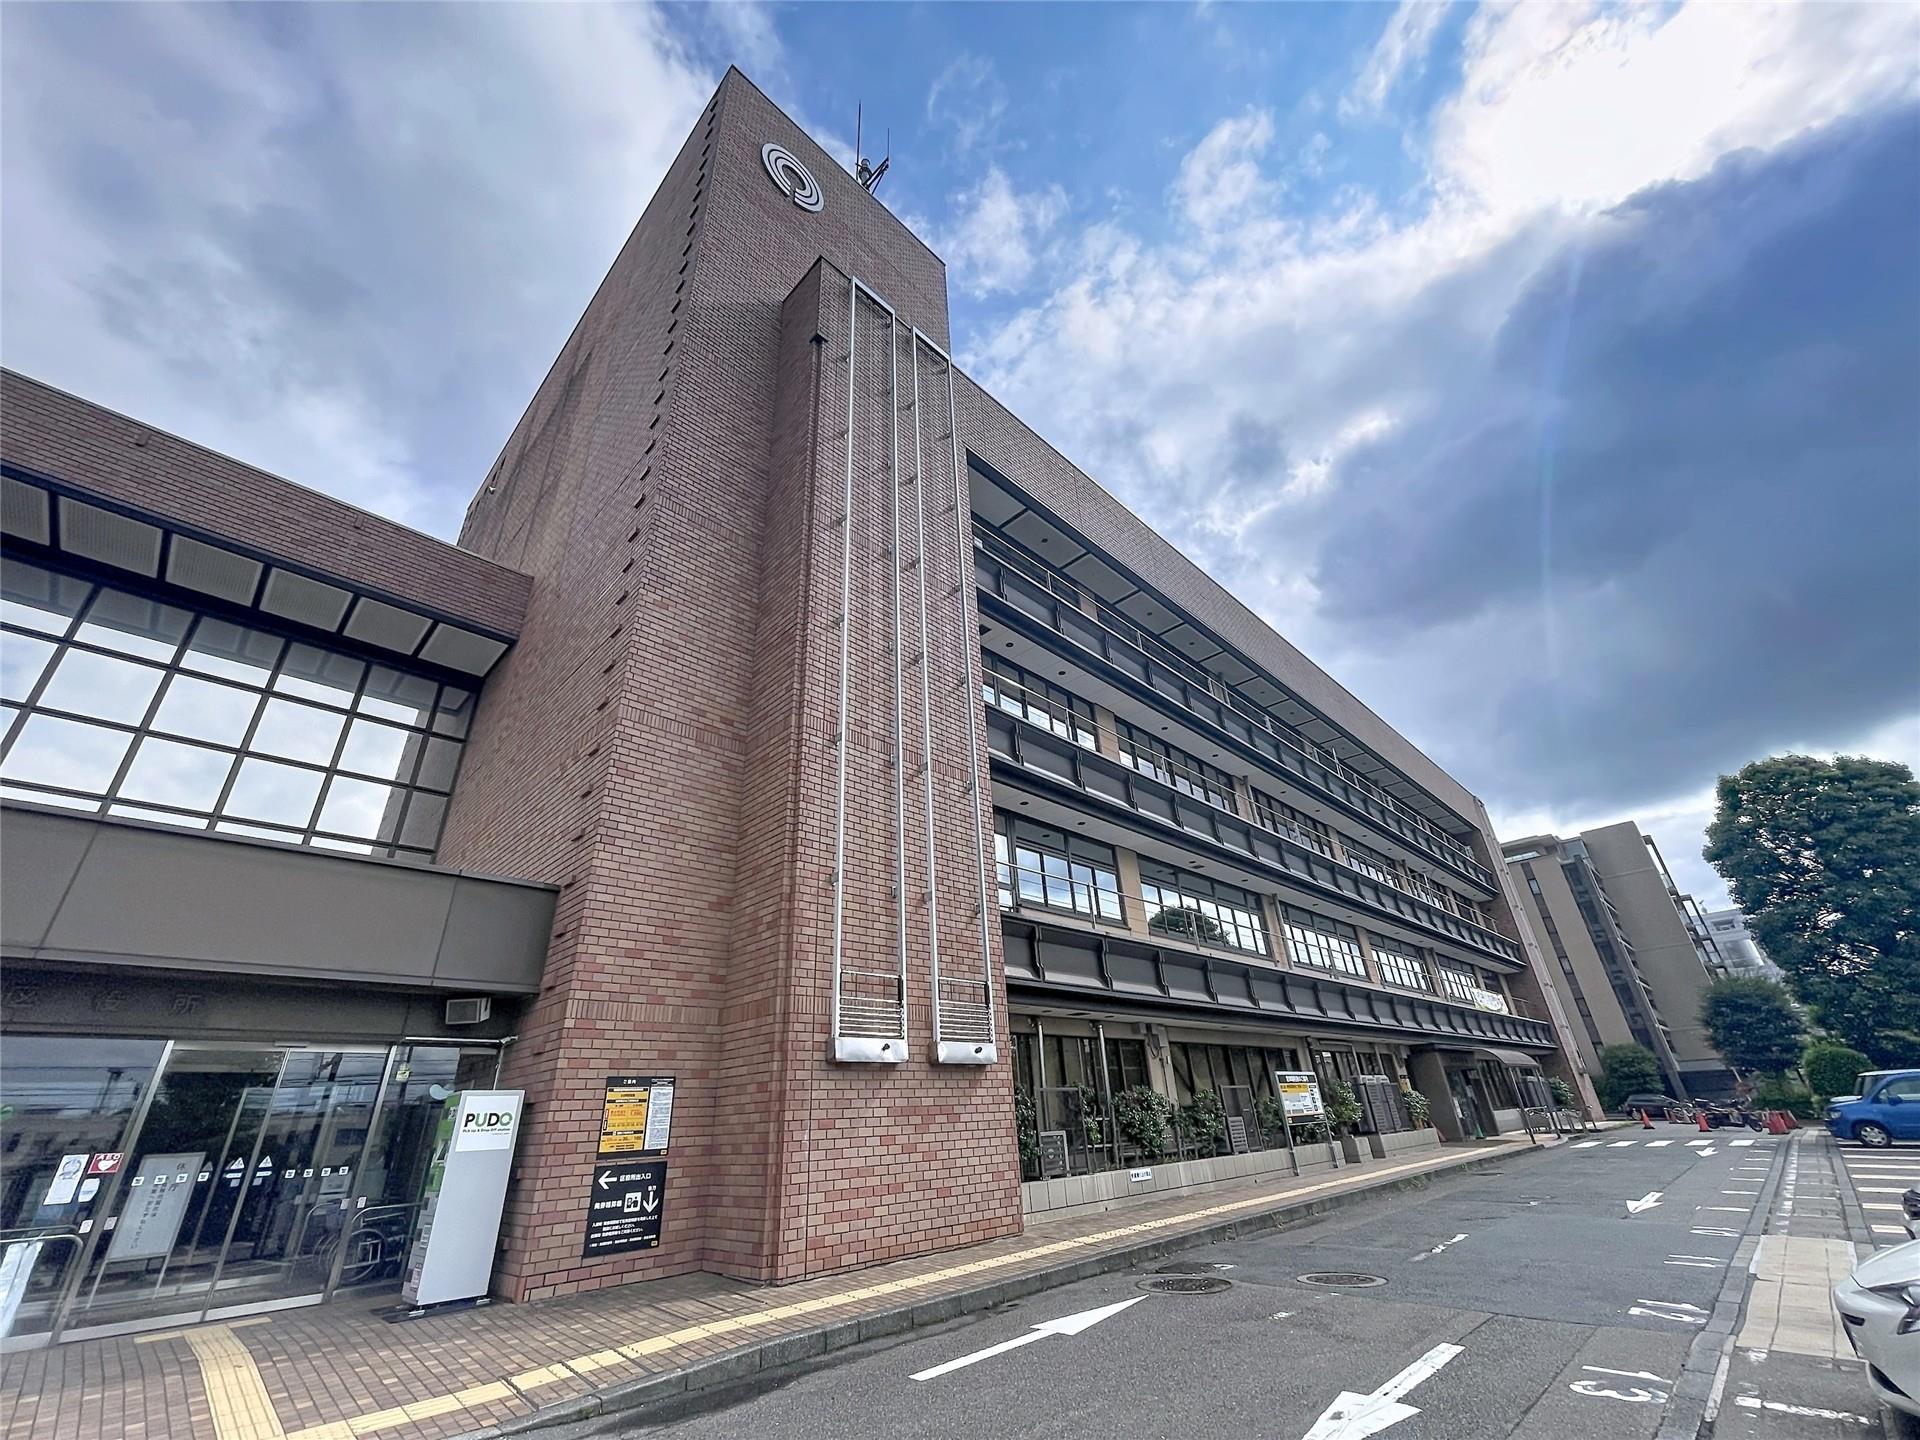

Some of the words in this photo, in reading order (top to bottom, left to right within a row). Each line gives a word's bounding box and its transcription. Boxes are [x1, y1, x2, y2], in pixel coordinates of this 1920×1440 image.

[464, 1112, 513, 1127] PUDO
[1628, 1299, 1711, 1323] 12
[1569, 1365, 1673, 1403] 13
